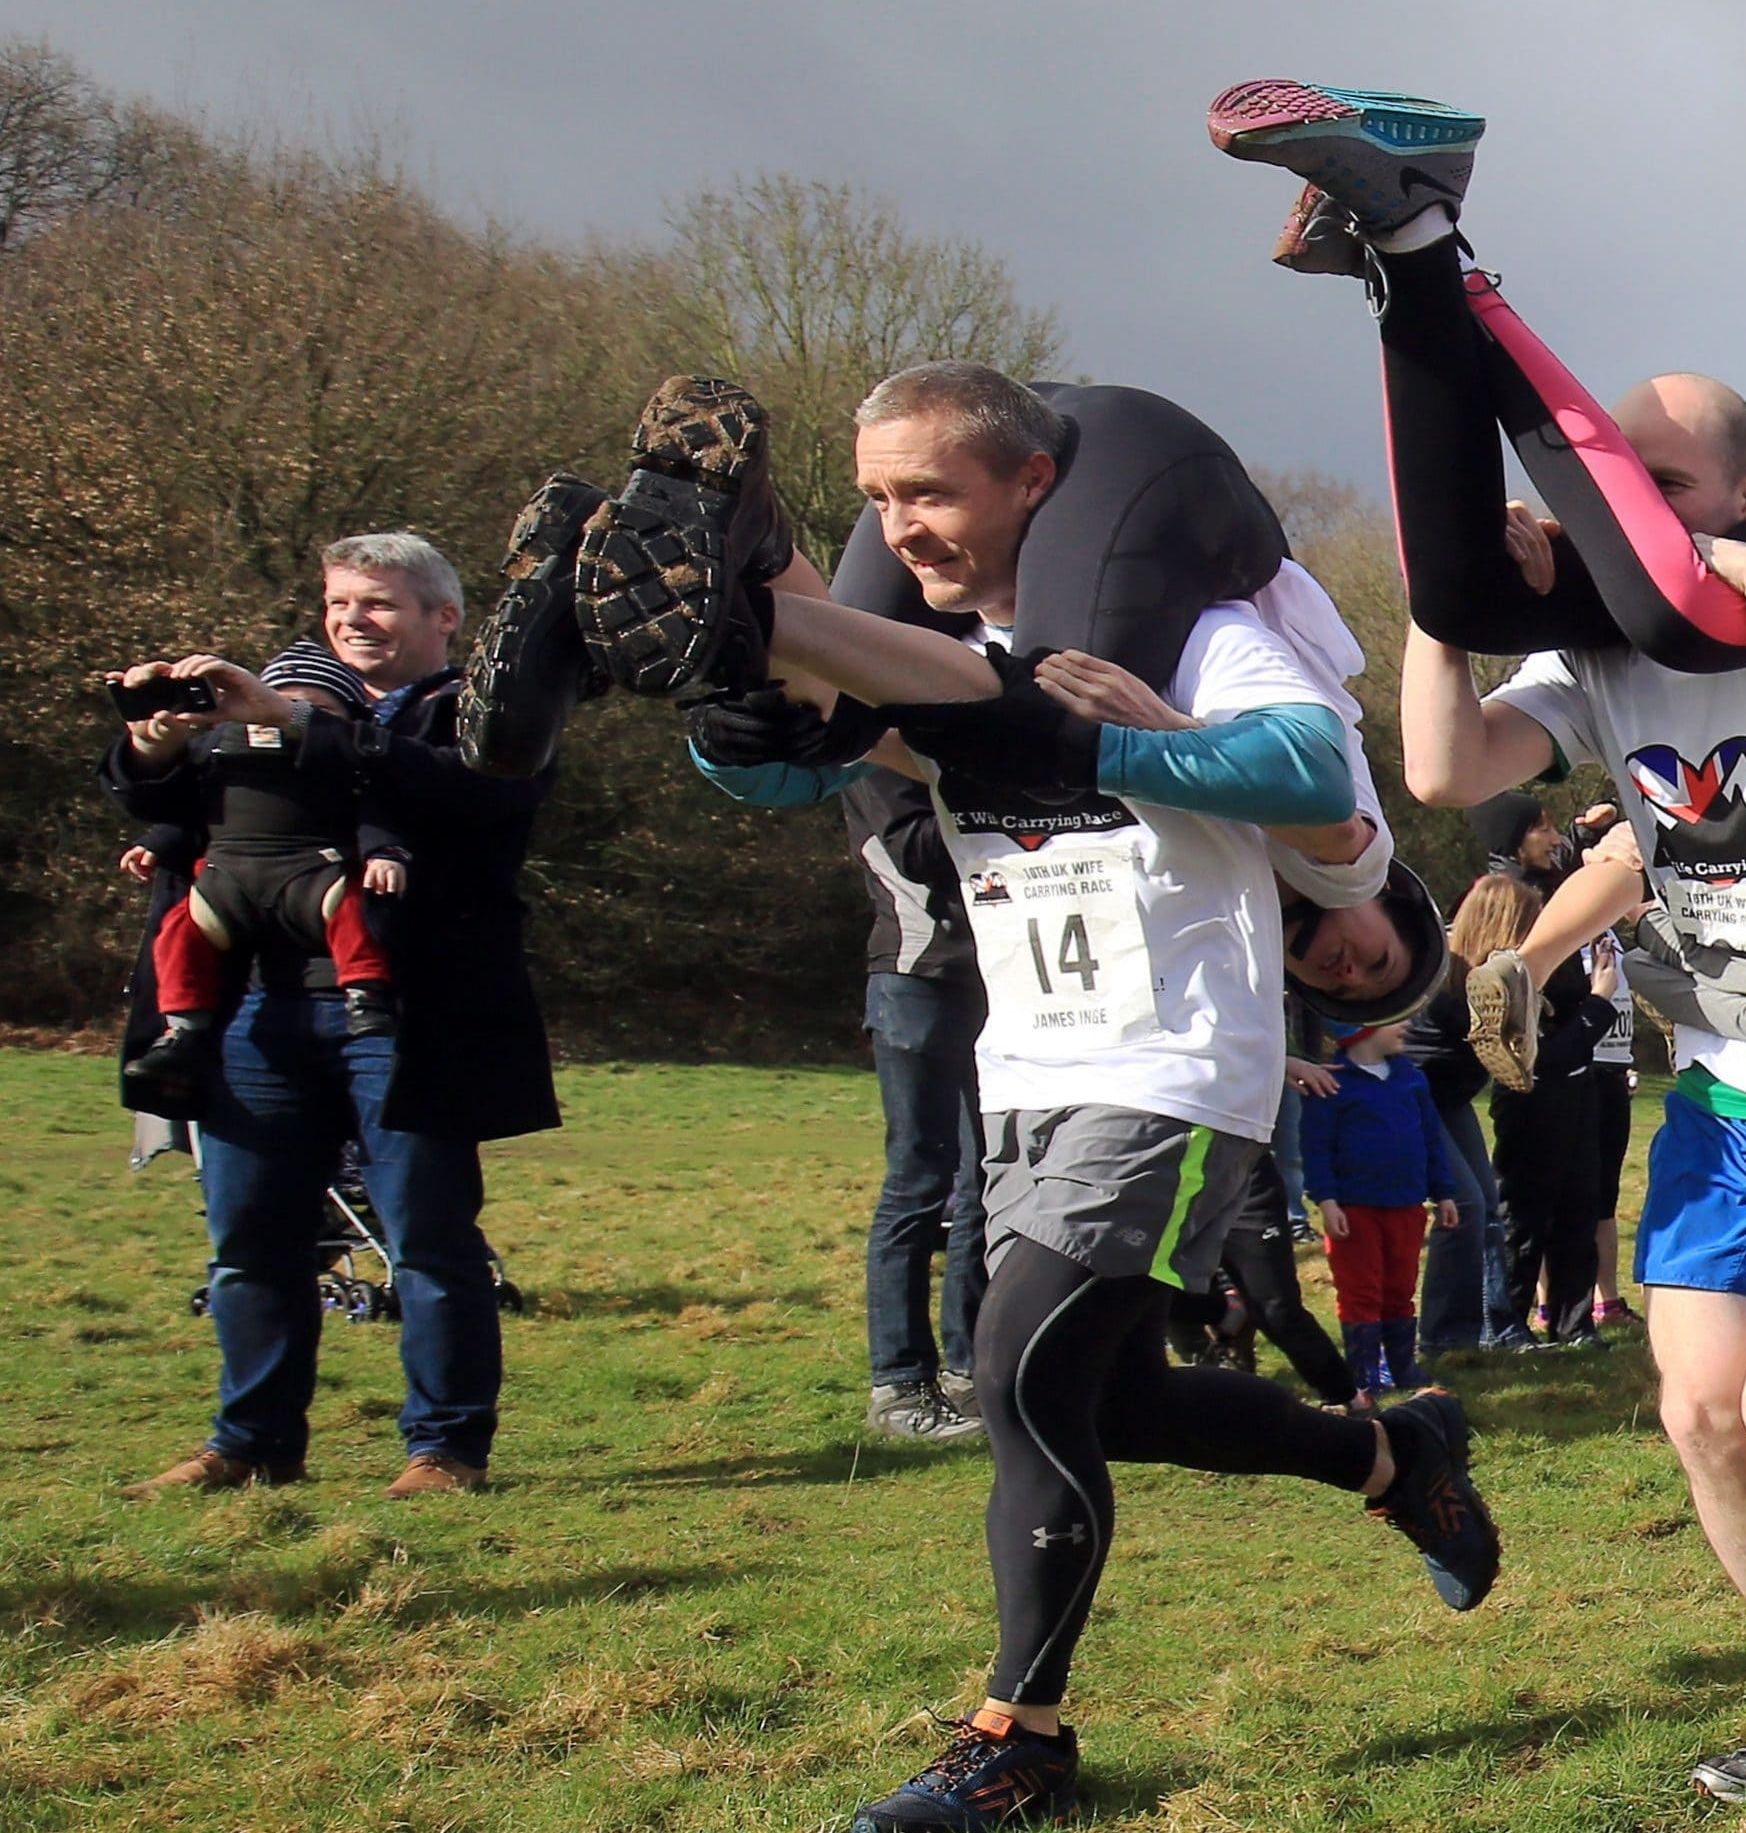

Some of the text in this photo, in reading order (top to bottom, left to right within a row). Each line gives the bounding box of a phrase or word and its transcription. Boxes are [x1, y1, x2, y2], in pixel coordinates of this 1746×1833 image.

[1002, 814, 1081, 830] Carrying
[1022, 860, 1104, 880] 10TH UK WIFE
[1024, 879, 1113, 899] CARRYING RACE
[1686, 892, 1714, 904] 10TH
[1717, 895, 1733, 907] UK
[1681, 907, 1737, 924] CARRYING
[1027, 914, 1099, 994] 14
[1032, 1008, 1108, 1030] JAMES INGE
